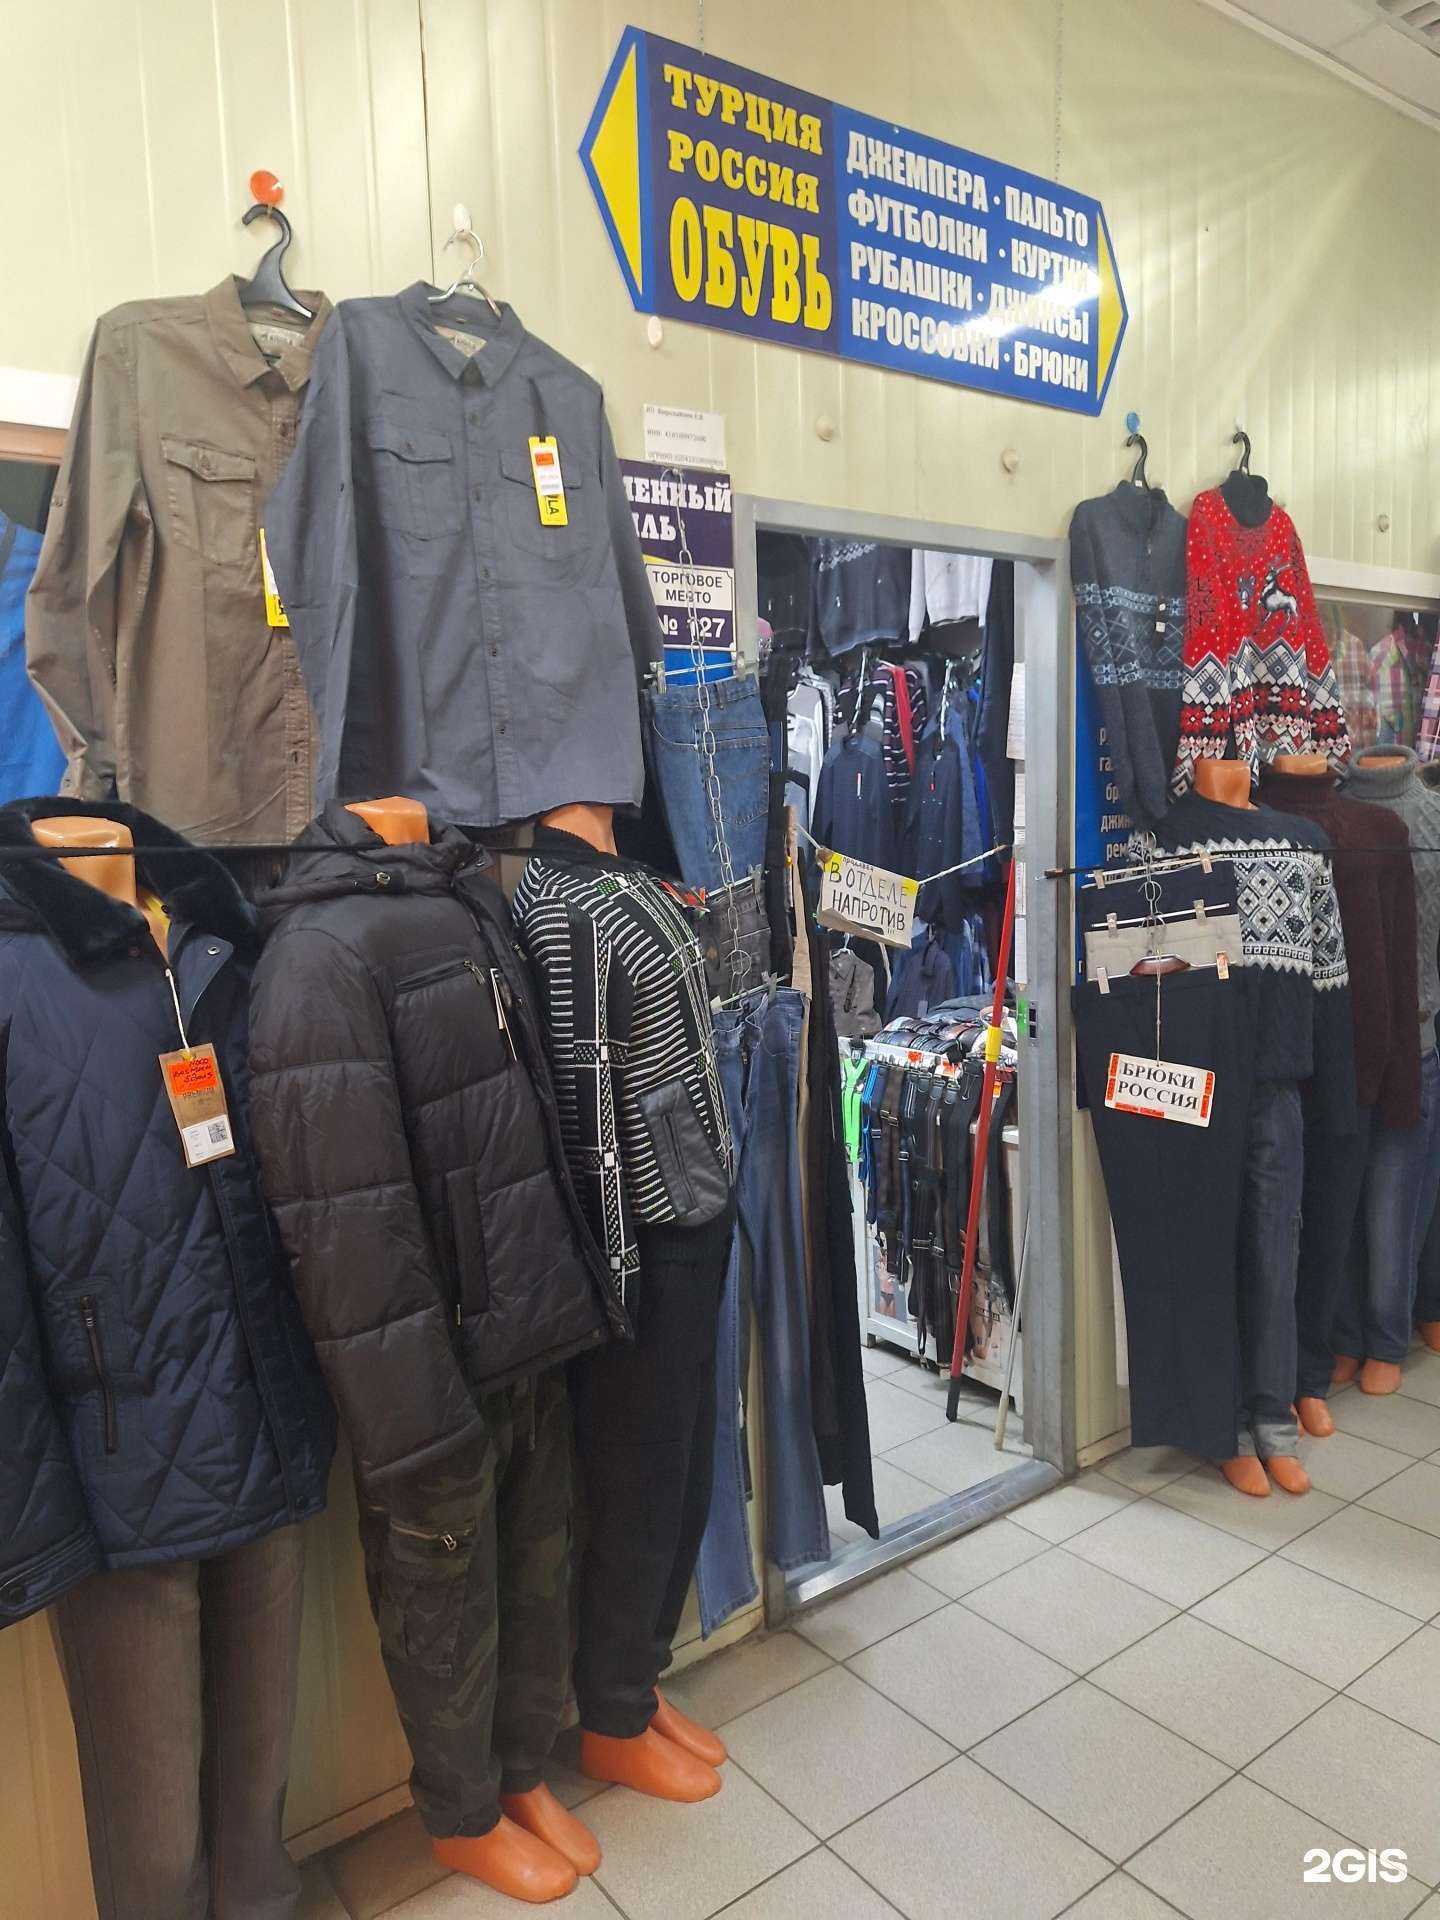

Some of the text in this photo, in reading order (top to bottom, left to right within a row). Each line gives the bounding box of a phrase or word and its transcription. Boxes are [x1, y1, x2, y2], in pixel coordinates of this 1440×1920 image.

[663, 63, 823, 155] ТУРЦИЯ
[667, 129, 820, 214] РОССИЯ
[847, 130, 1089, 248] ДЖЕМПЕРА ПАЛЬТО
[847, 188, 988, 264] ФУТБОЛКИ
[669, 196, 832, 331] ОБУВЬ
[850, 241, 973, 311] РУБАШКИ
[1014, 340, 1089, 393] БРЮКИ
[653, 571, 723, 588] ТОРГОВОЕ
[832, 889, 905, 931] НАПРОТИВ
[846, 867, 907, 909] ОТДЕЛЕ
[1118, 1080, 1199, 1110] РОССИЯ
[1123, 1062, 1195, 1090] БРЮКИ
